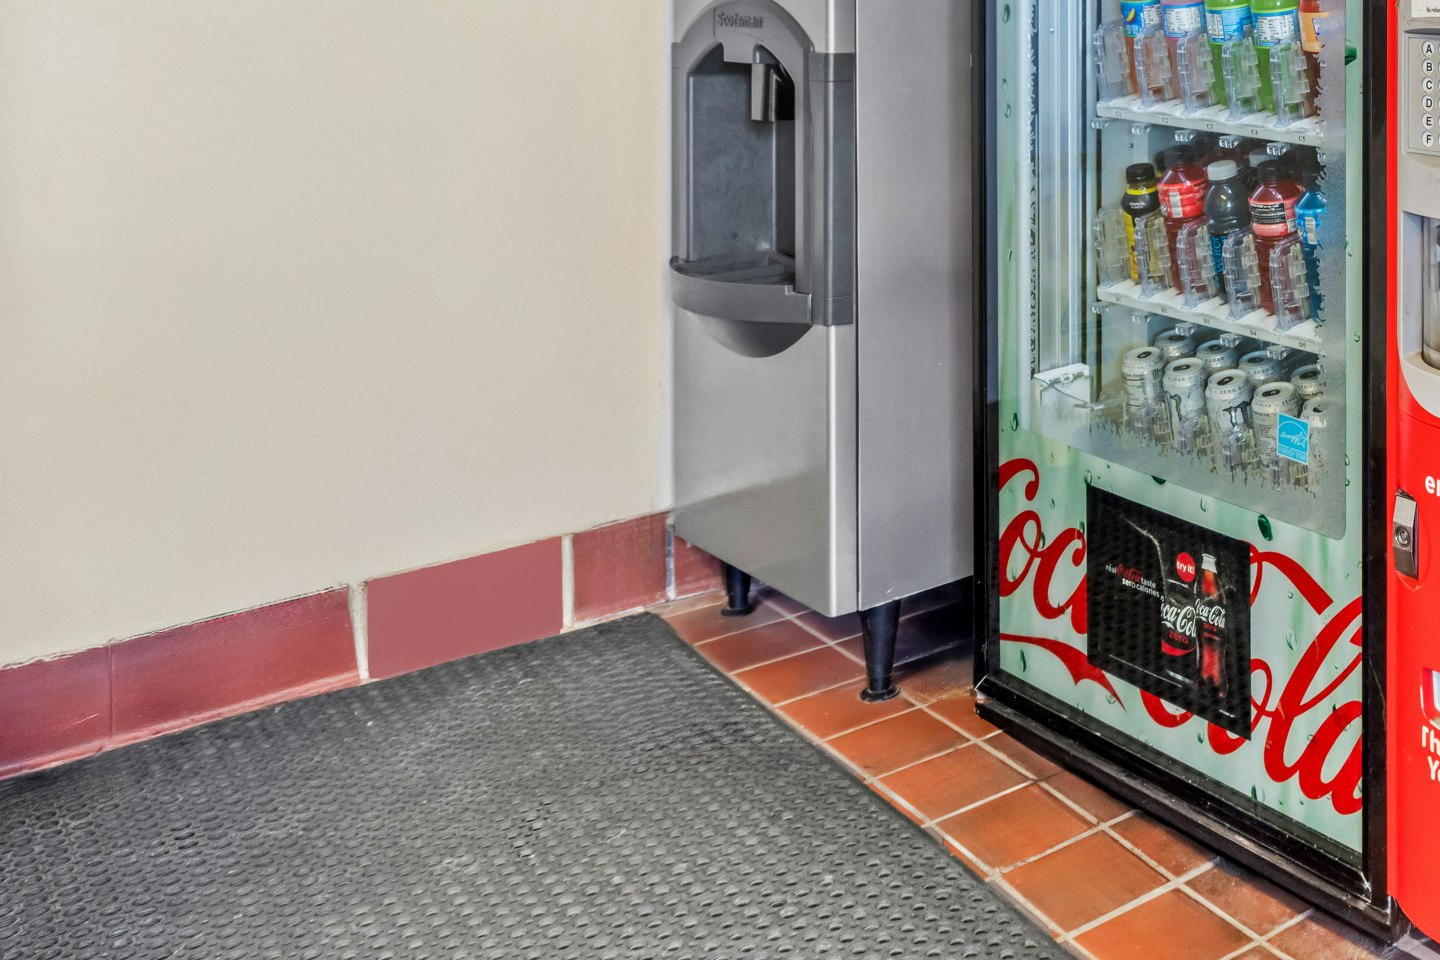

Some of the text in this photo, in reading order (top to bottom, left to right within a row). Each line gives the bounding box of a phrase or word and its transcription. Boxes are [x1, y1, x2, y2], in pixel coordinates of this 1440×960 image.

[718, 12, 763, 28] Scotsman
[1426, 44, 1433, 54] A
[1426, 62, 1433, 72] B
[1426, 80, 1433, 90] C
[1426, 98, 1433, 108] D
[1426, 116, 1432, 126] E
[1426, 134, 1432, 144] F
[1177, 560, 1195, 575] try it!
[1121, 577, 1160, 598] zero calories
[1141, 577, 1156, 589] taste
